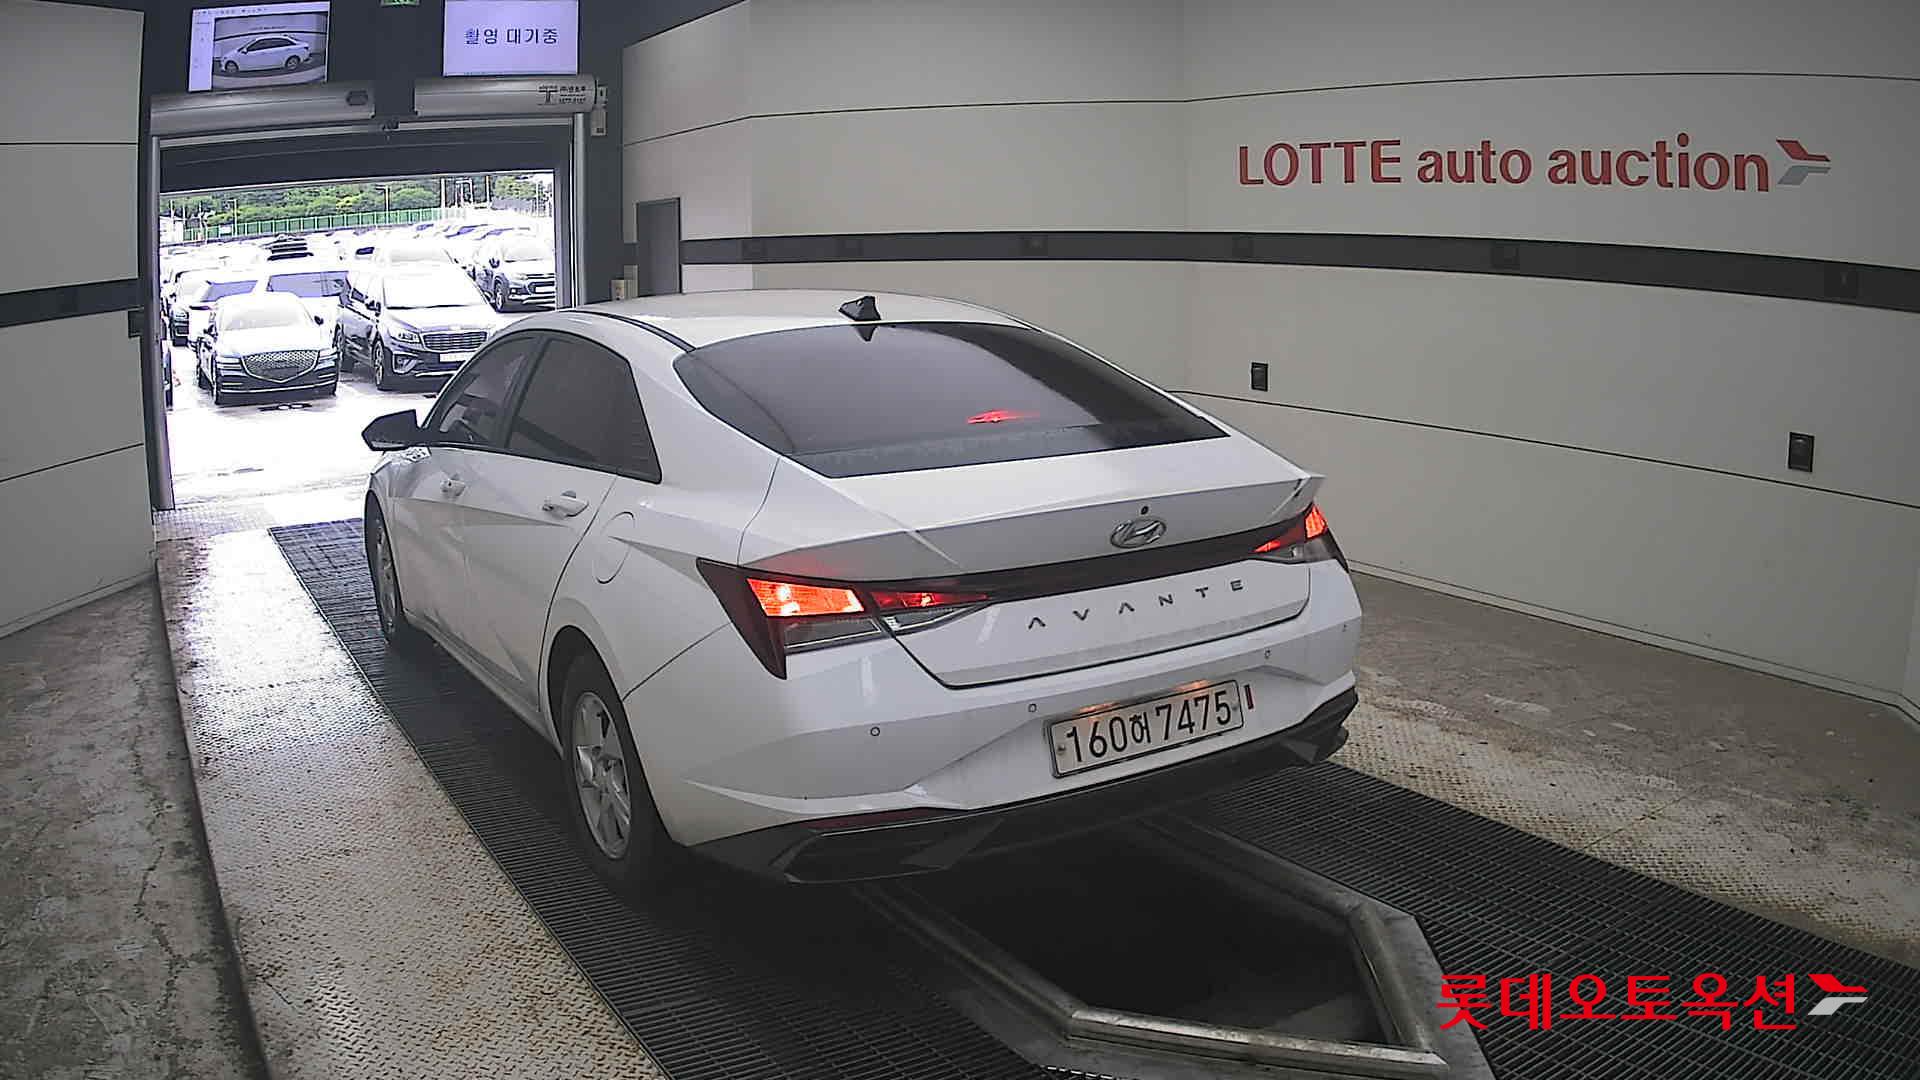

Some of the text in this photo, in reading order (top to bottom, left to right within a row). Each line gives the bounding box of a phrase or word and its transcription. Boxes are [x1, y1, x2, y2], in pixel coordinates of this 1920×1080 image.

[506, 28, 559, 45] 대기중
[1238, 132, 1770, 192] LOTTE auto auction
[1027, 578, 1245, 630] AVANTE
